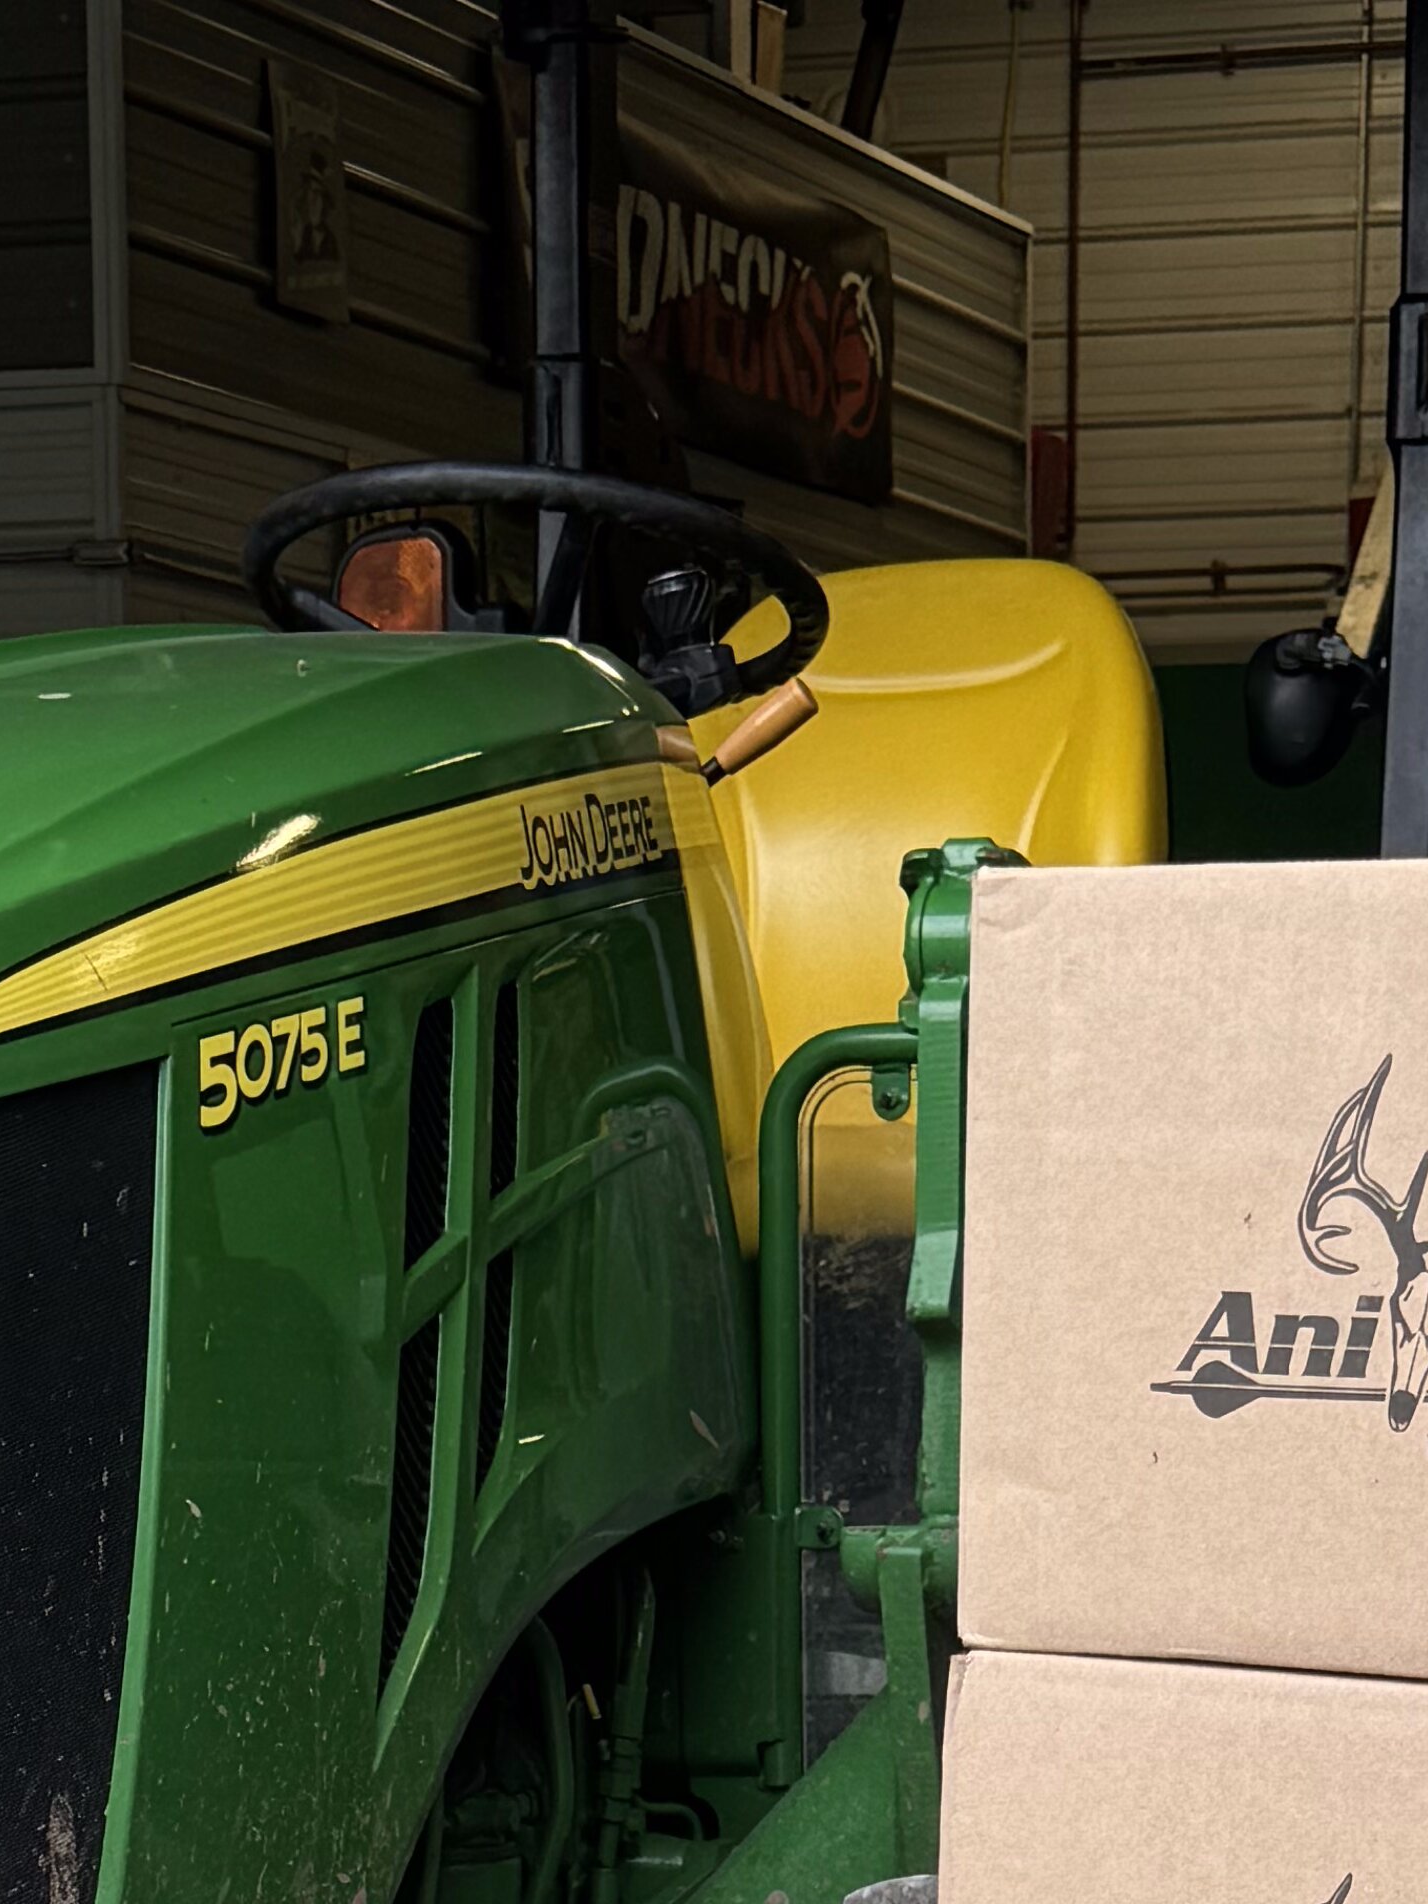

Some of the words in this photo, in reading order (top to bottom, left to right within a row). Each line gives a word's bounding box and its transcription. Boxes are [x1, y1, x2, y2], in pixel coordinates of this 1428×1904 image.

[519, 803, 589, 885] JOHN
[584, 792, 659, 866] DEERE
[1175, 1290, 1385, 1377] Ani
